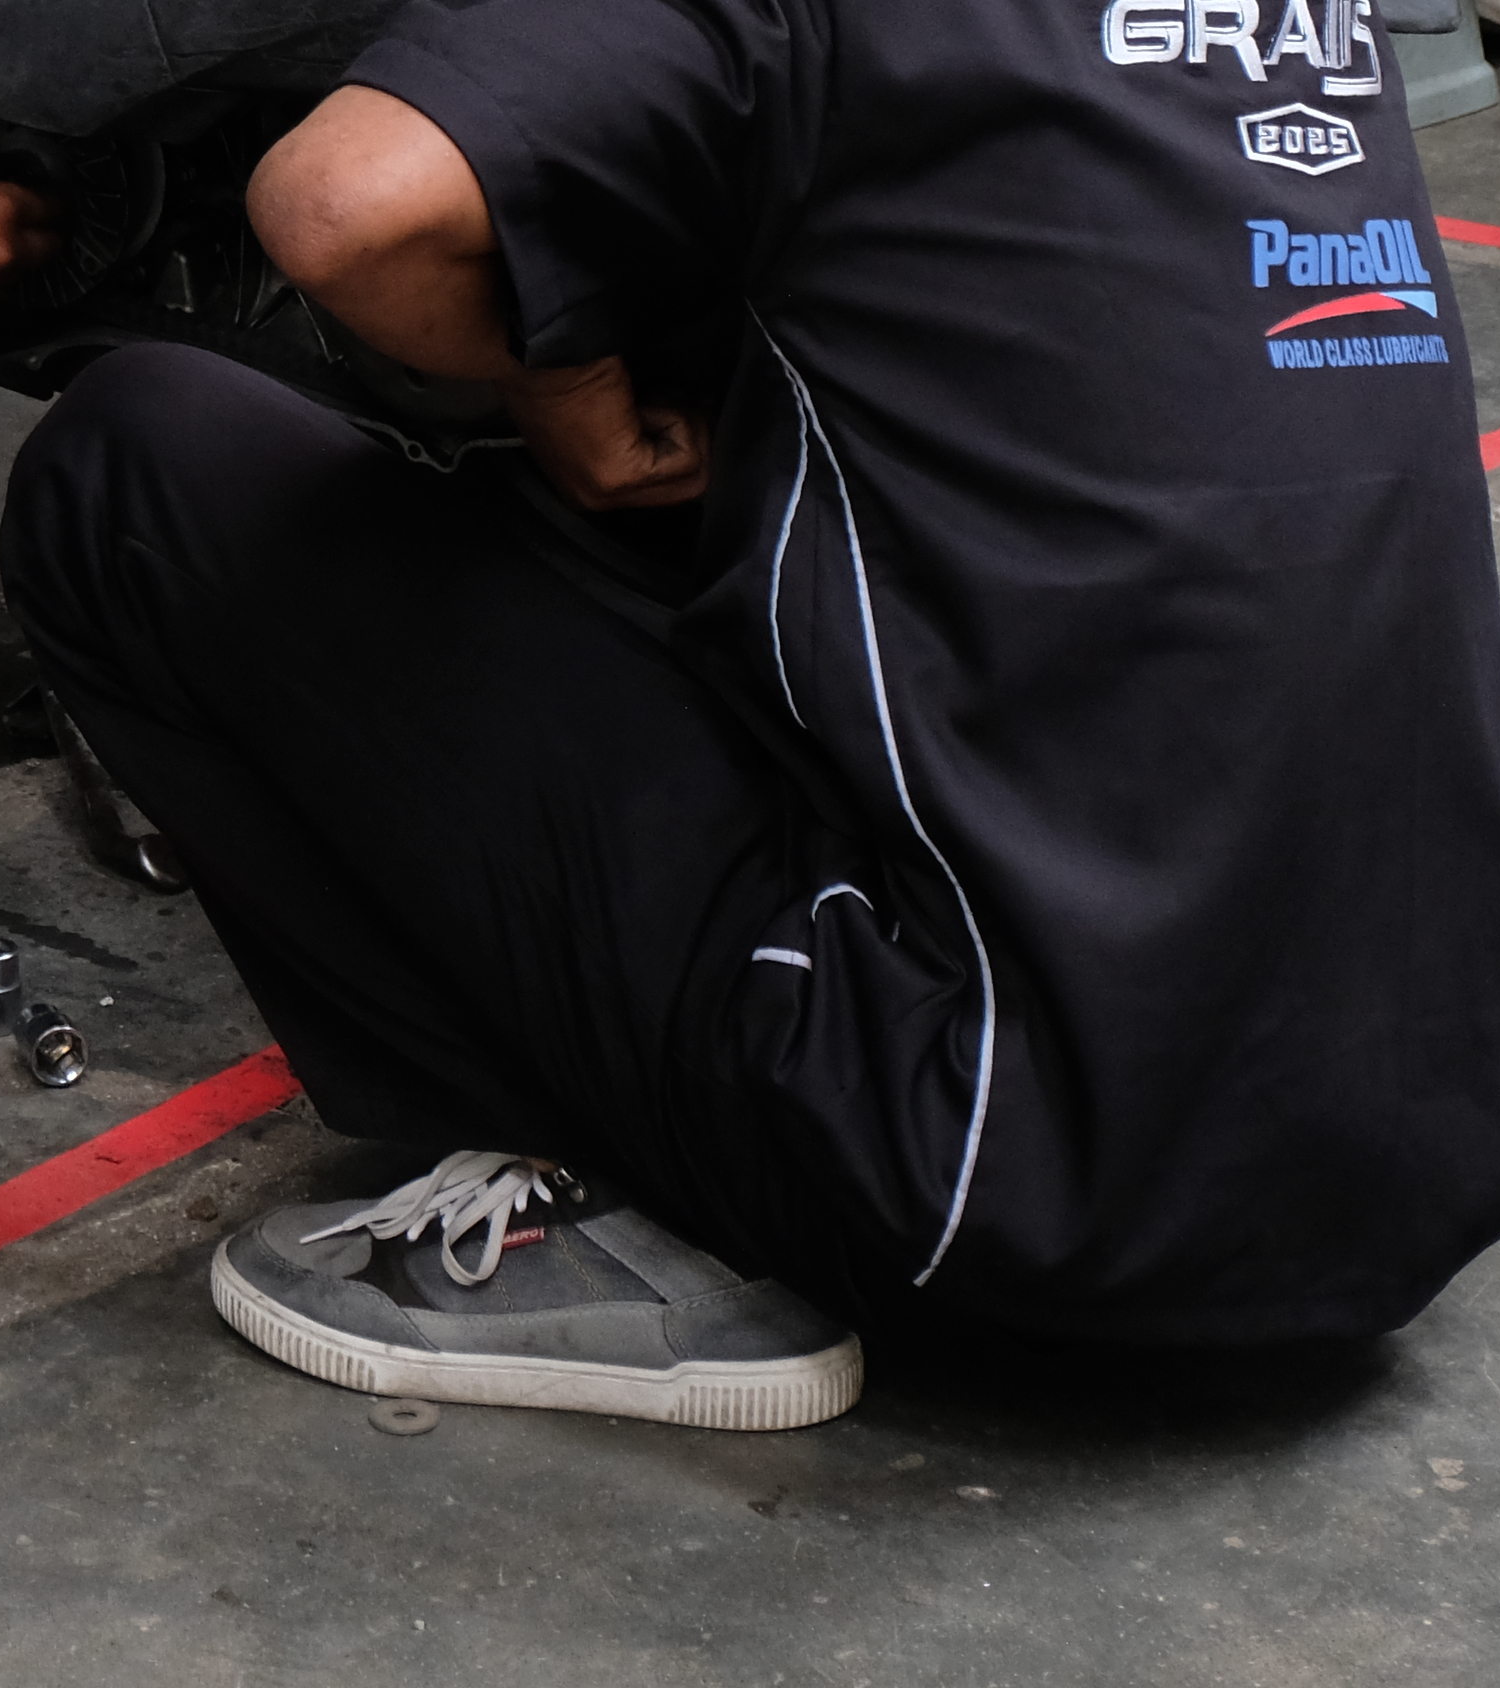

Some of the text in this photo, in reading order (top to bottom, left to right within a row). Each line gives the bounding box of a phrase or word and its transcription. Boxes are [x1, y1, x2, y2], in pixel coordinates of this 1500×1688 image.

[1256, 124, 1351, 155] 2025
[1245, 218, 1433, 288] PanaOIL
[1267, 334, 1450, 369] WORLD CLASS LUBRICANTS
